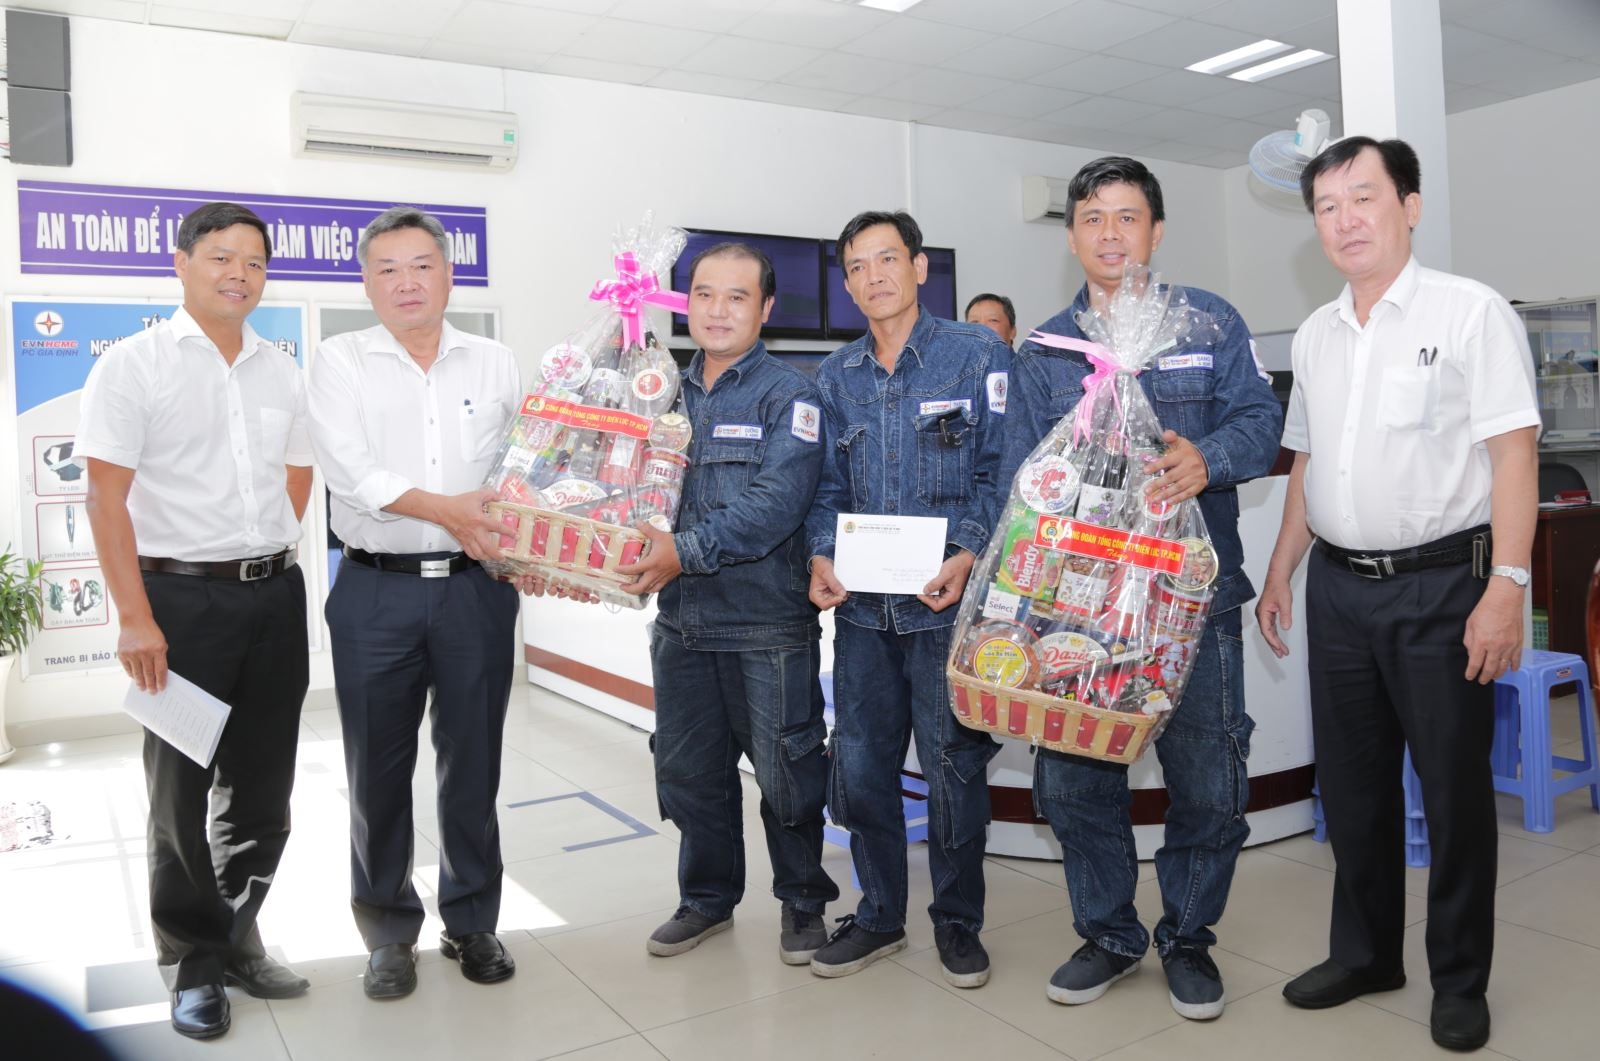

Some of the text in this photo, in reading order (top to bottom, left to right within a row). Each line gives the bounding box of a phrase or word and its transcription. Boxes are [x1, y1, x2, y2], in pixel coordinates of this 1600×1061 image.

[36, 211, 66, 250] AN
[72, 209, 128, 253] TOÀN
[134, 205, 161, 254] ĐỂ
[268, 218, 306, 259] LÀM
[311, 220, 353, 267] VIỆC
[21, 340, 79, 349] EVNHCMC
[55, 349, 79, 358] ĐỊNH
[1014, 545, 1040, 588] Blendy
[988, 600, 1014, 614] Select
[44, 655, 76, 666] TRANG
[92, 650, 111, 661] BẢO
